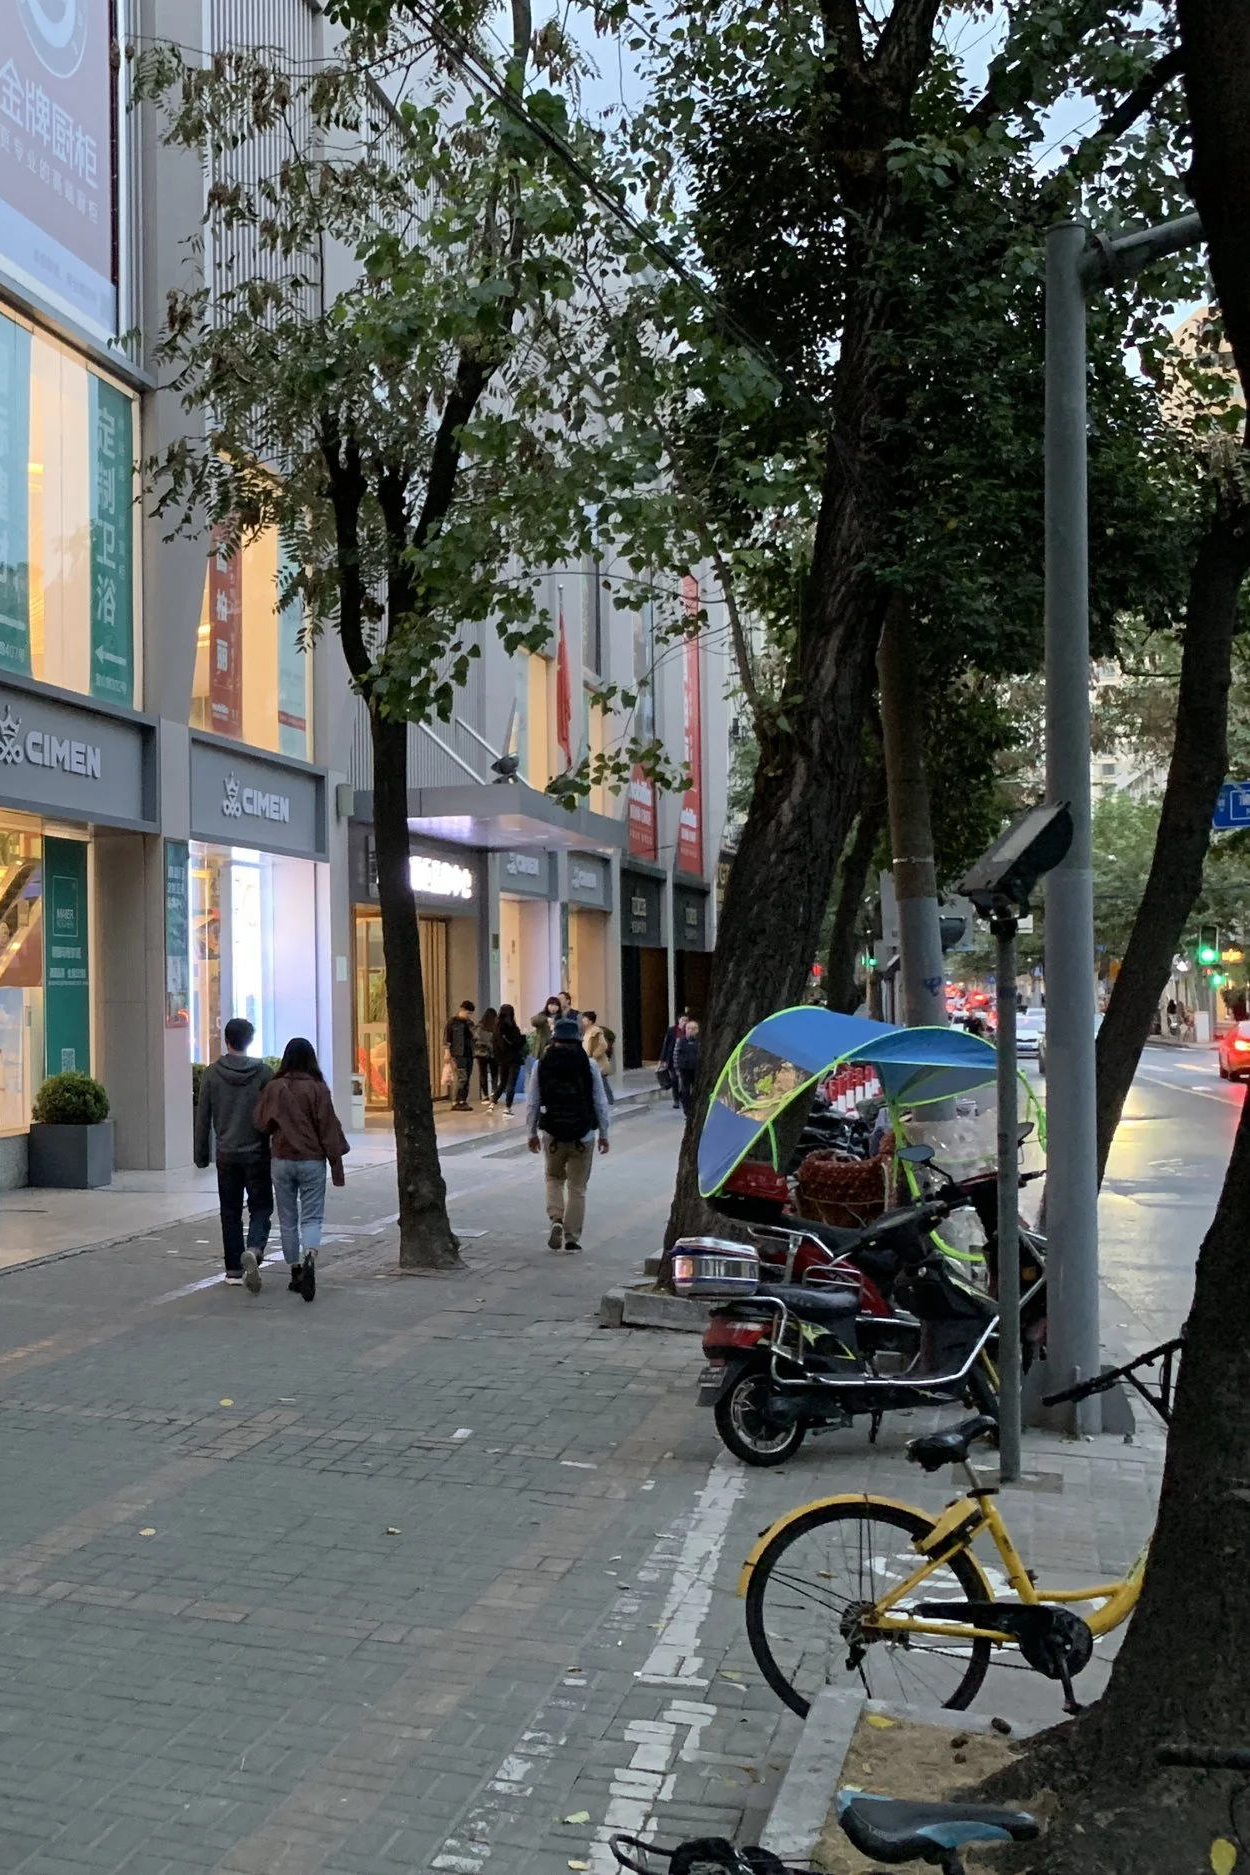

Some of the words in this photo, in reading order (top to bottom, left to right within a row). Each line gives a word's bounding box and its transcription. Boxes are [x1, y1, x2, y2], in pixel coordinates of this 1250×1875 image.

[95, 407, 118, 628] 定制卫浴
[24, 731, 101, 779] CIMEN
[242, 788, 290, 823] CIMEN
